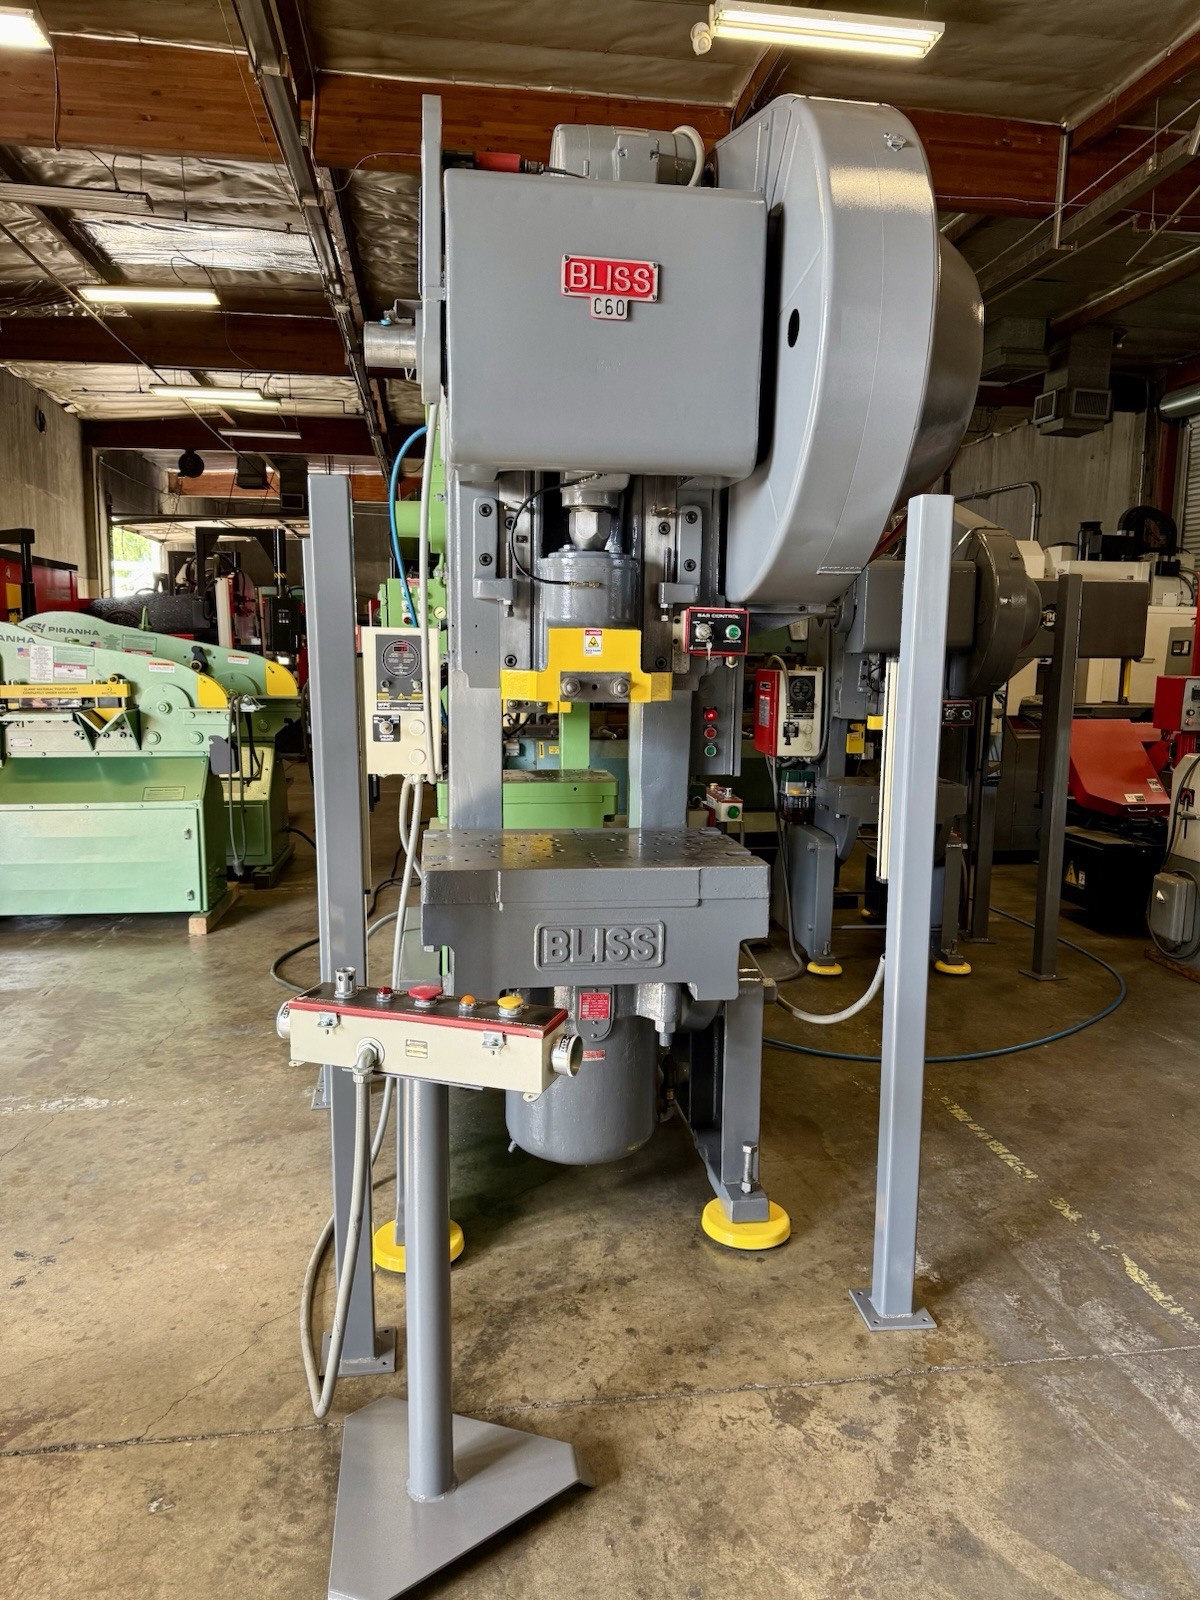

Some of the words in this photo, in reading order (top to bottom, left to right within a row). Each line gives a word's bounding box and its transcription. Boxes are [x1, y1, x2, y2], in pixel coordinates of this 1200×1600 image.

[568, 261, 651, 293] BLISS
[594, 297, 625, 316] C60
[48, 626, 100, 636] PIRANHA
[543, 926, 656, 963] BLISS
